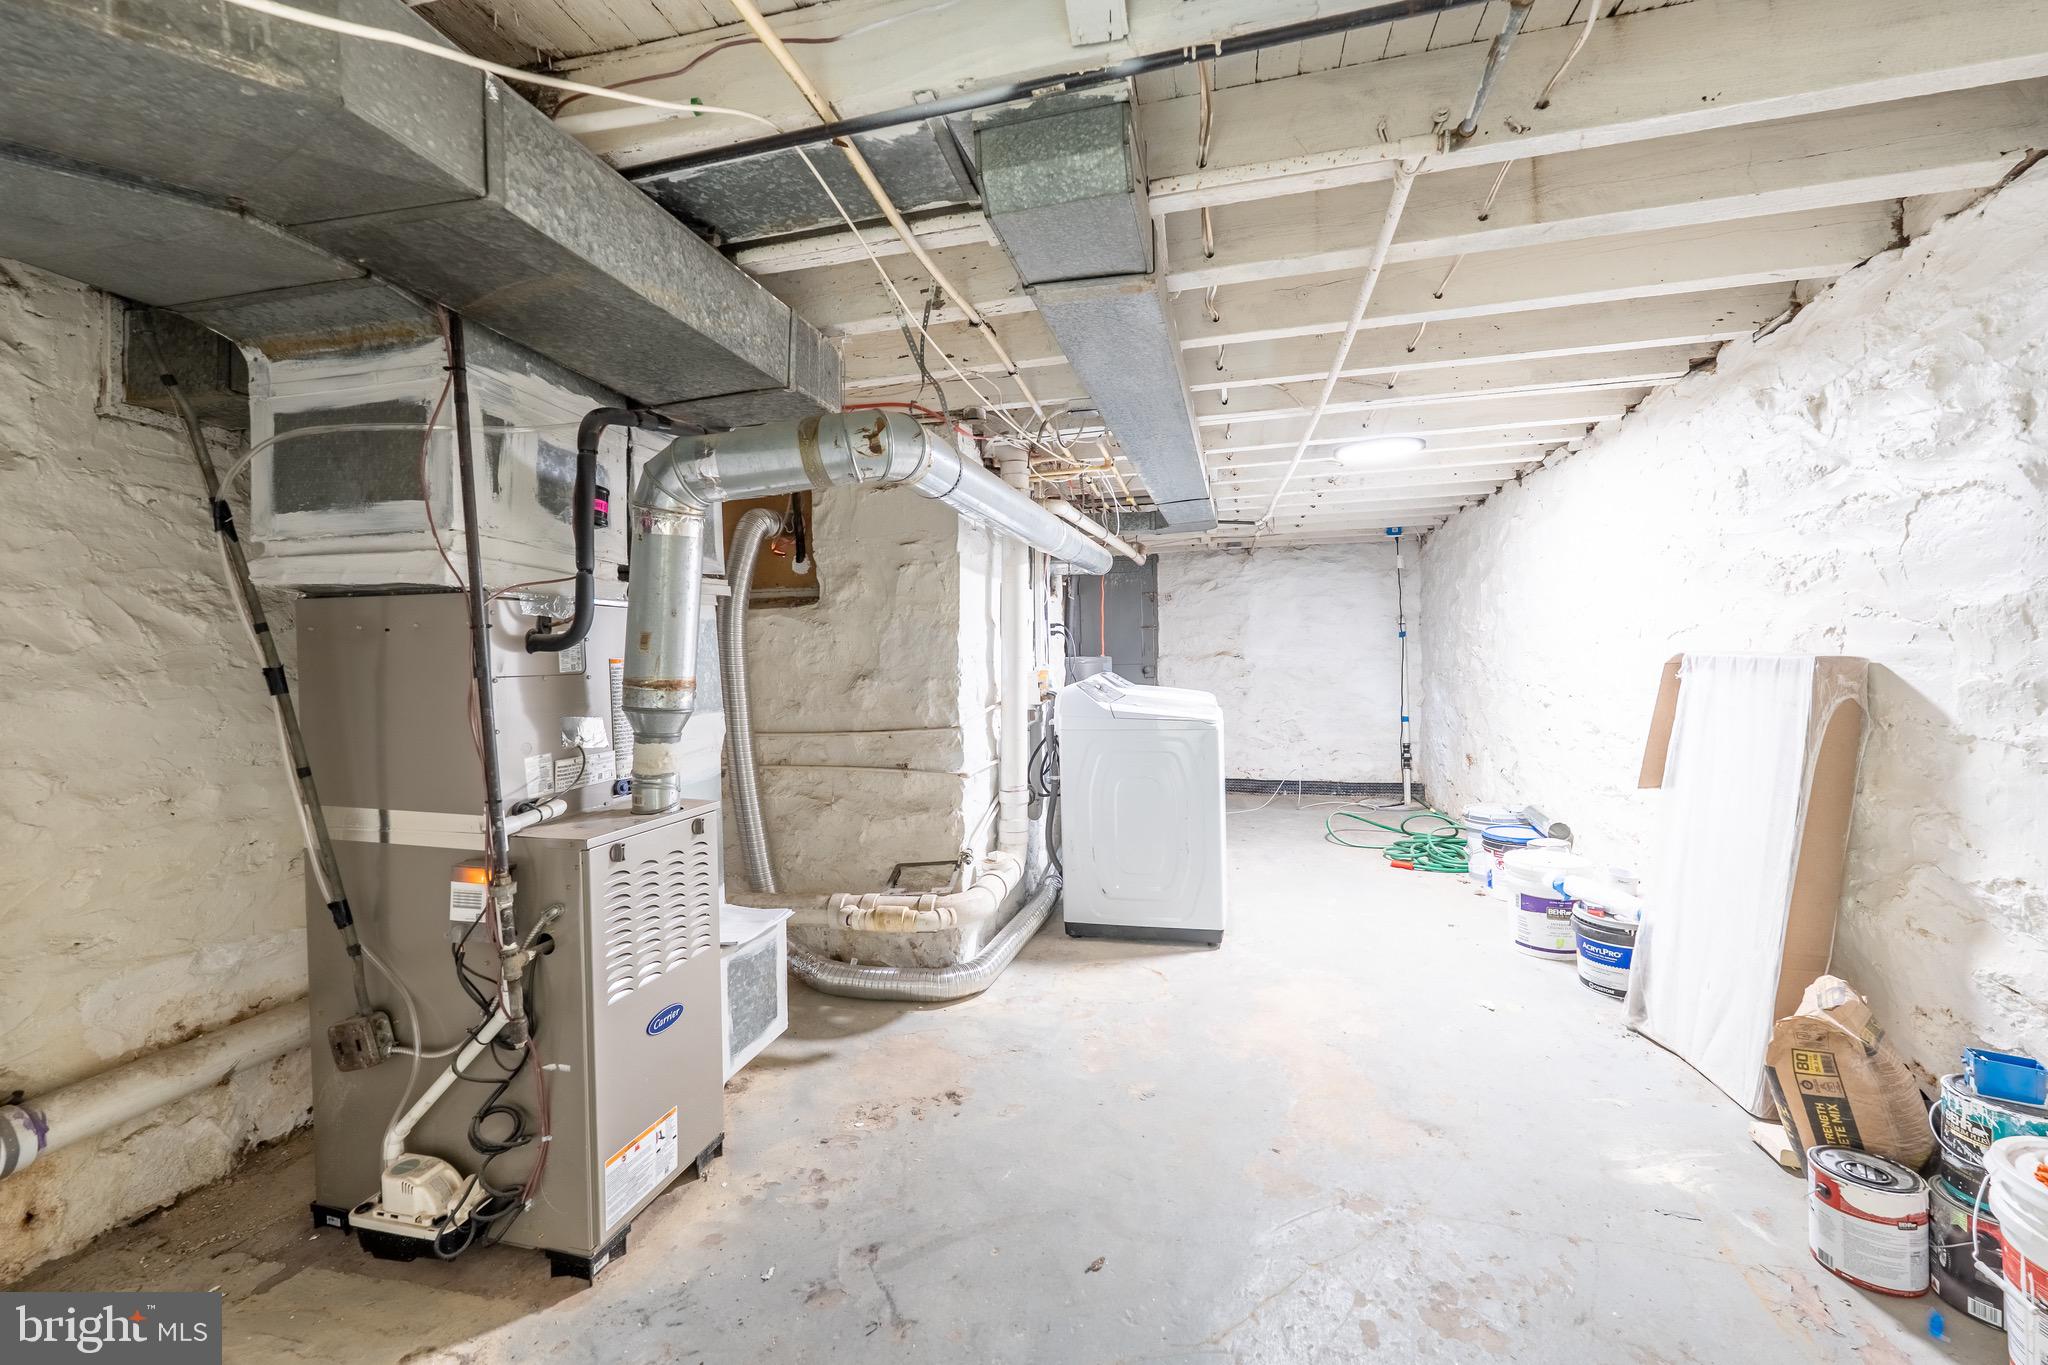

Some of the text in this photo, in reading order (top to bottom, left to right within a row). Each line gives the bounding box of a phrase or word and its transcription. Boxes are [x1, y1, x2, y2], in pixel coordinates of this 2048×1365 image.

[653, 1007, 680, 1031] Carrier
[1796, 1053, 1810, 1071] 80
[1814, 1102, 1836, 1144] TRENGTH
[1827, 1103, 1843, 1124] MIX
[1945, 1110, 1973, 1132] BEHR
